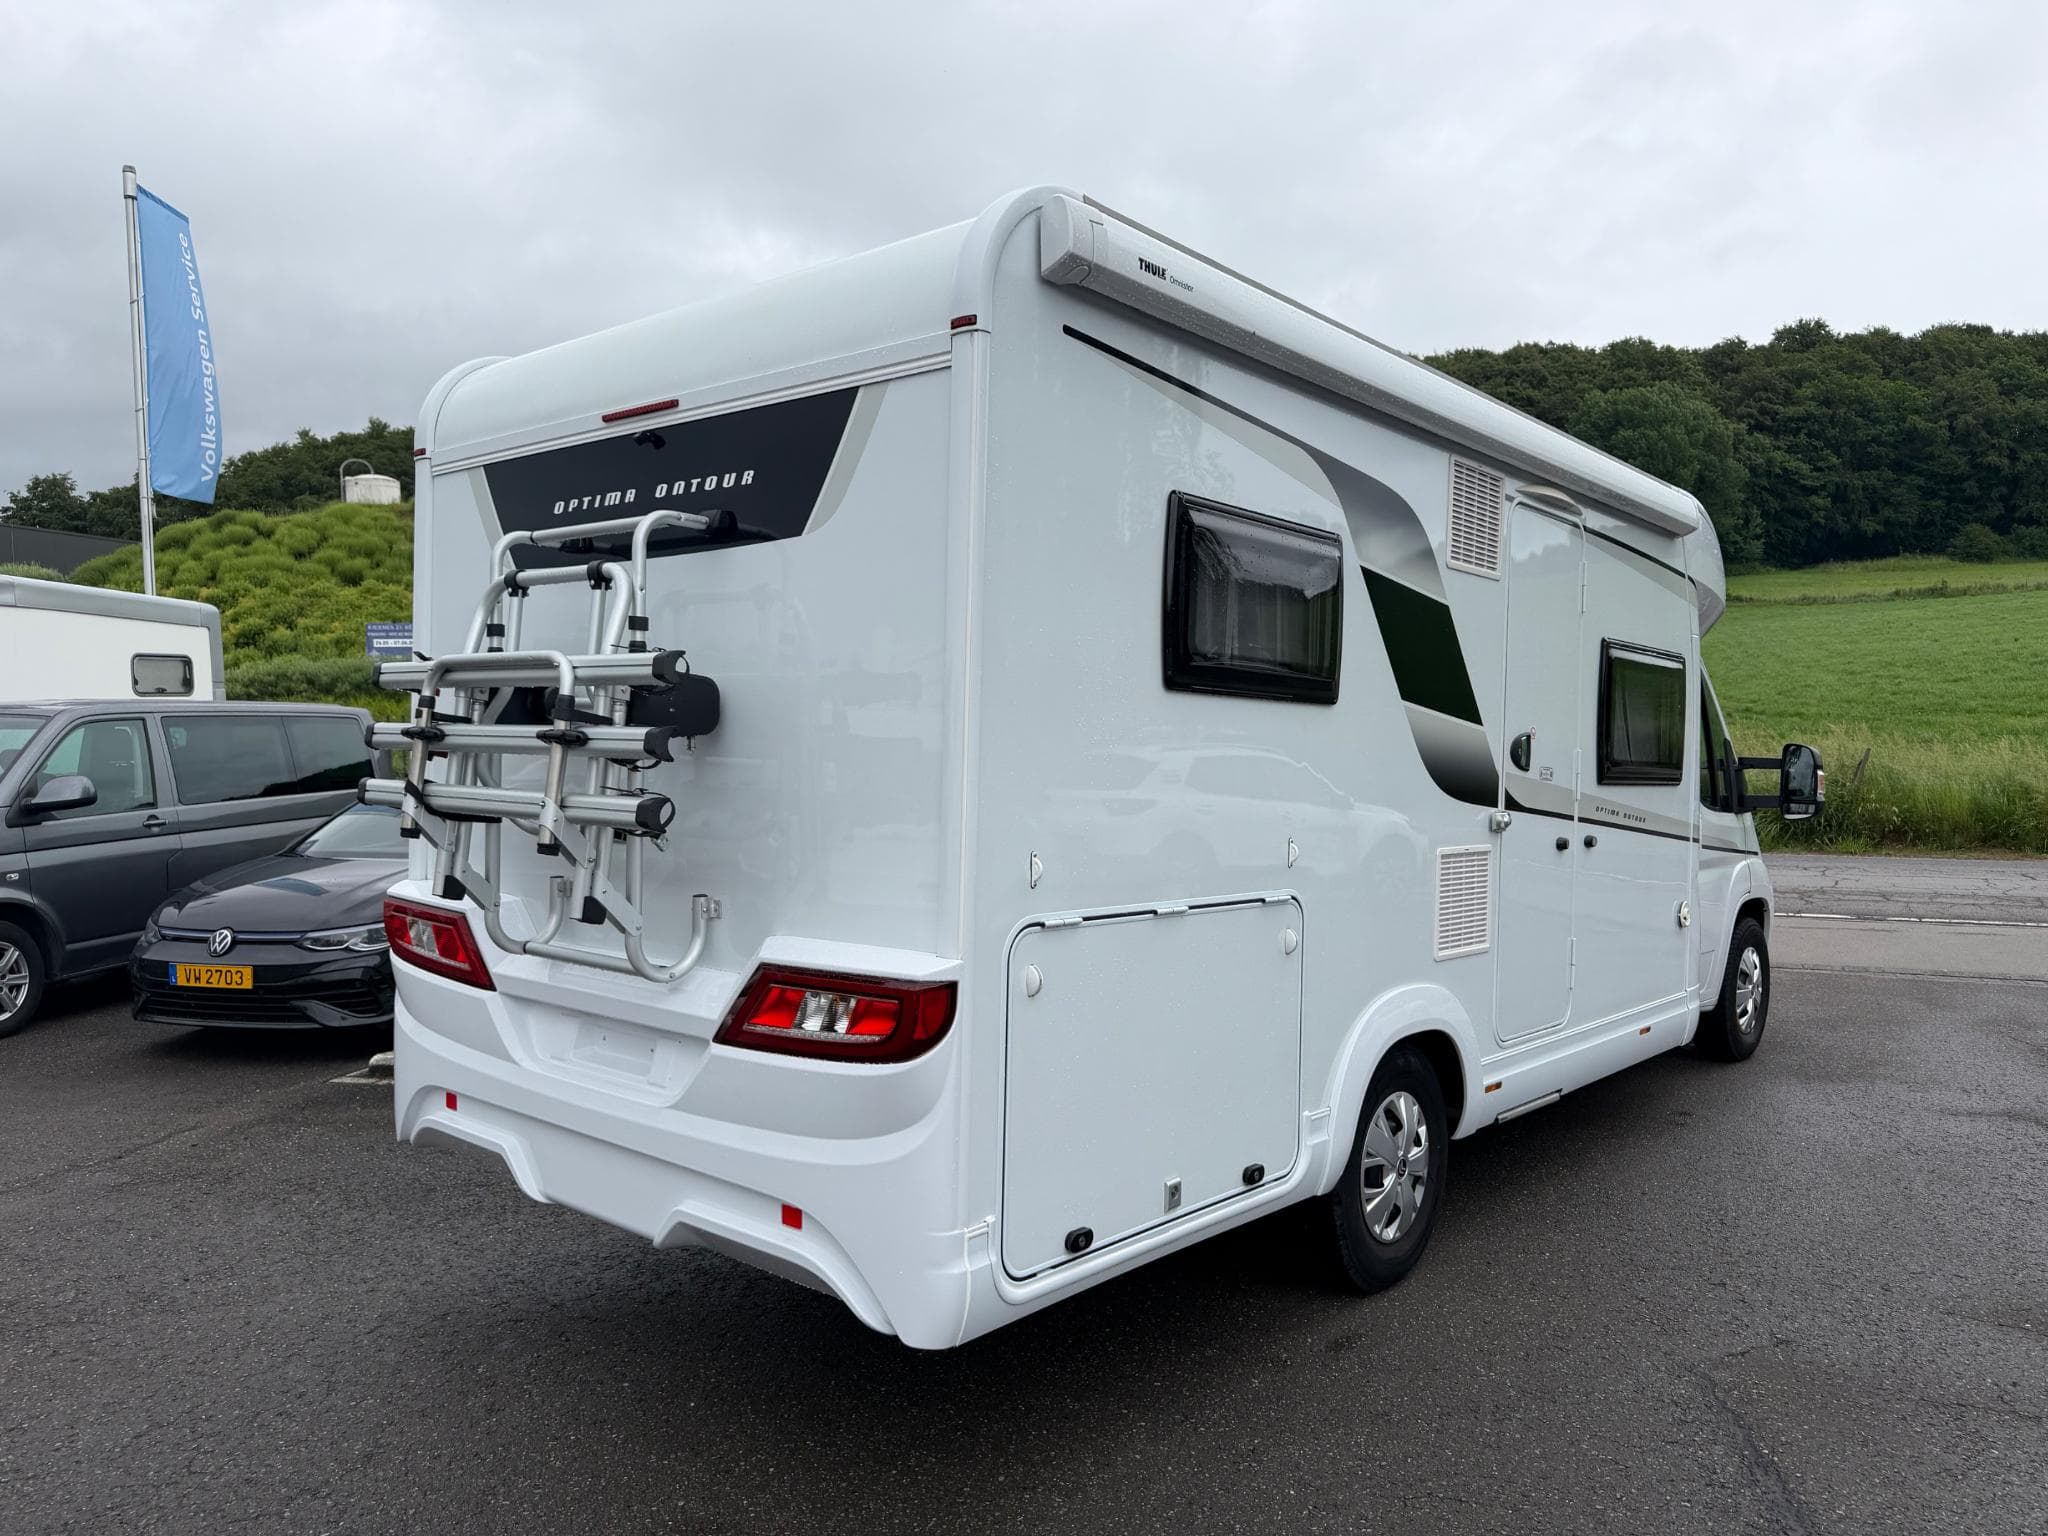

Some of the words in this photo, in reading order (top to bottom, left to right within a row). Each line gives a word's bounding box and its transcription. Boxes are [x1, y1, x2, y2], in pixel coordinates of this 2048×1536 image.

[180, 232, 204, 323] Service
[1138, 257, 1167, 280] THULE
[199, 330, 217, 482] Volkswagen
[553, 488, 636, 515] OPTIMA
[655, 470, 755, 498] ONTOUR
